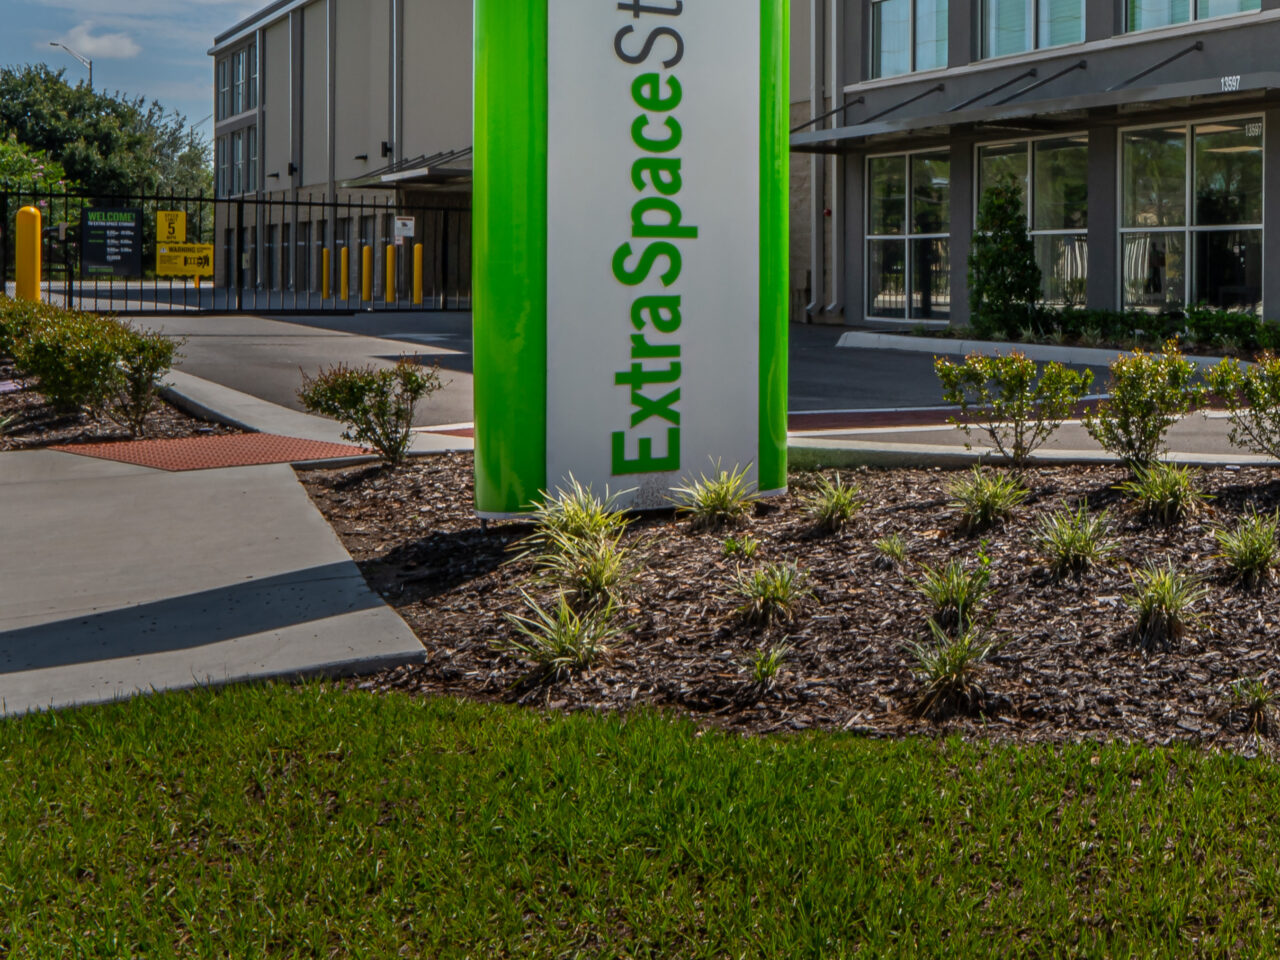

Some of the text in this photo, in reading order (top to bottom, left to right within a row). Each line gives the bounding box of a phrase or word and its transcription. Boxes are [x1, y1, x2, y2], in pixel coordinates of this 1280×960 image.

[1221, 75, 1240, 91] 13597
[1245, 123, 1262, 136] 13597
[168, 222, 175, 235] 5
